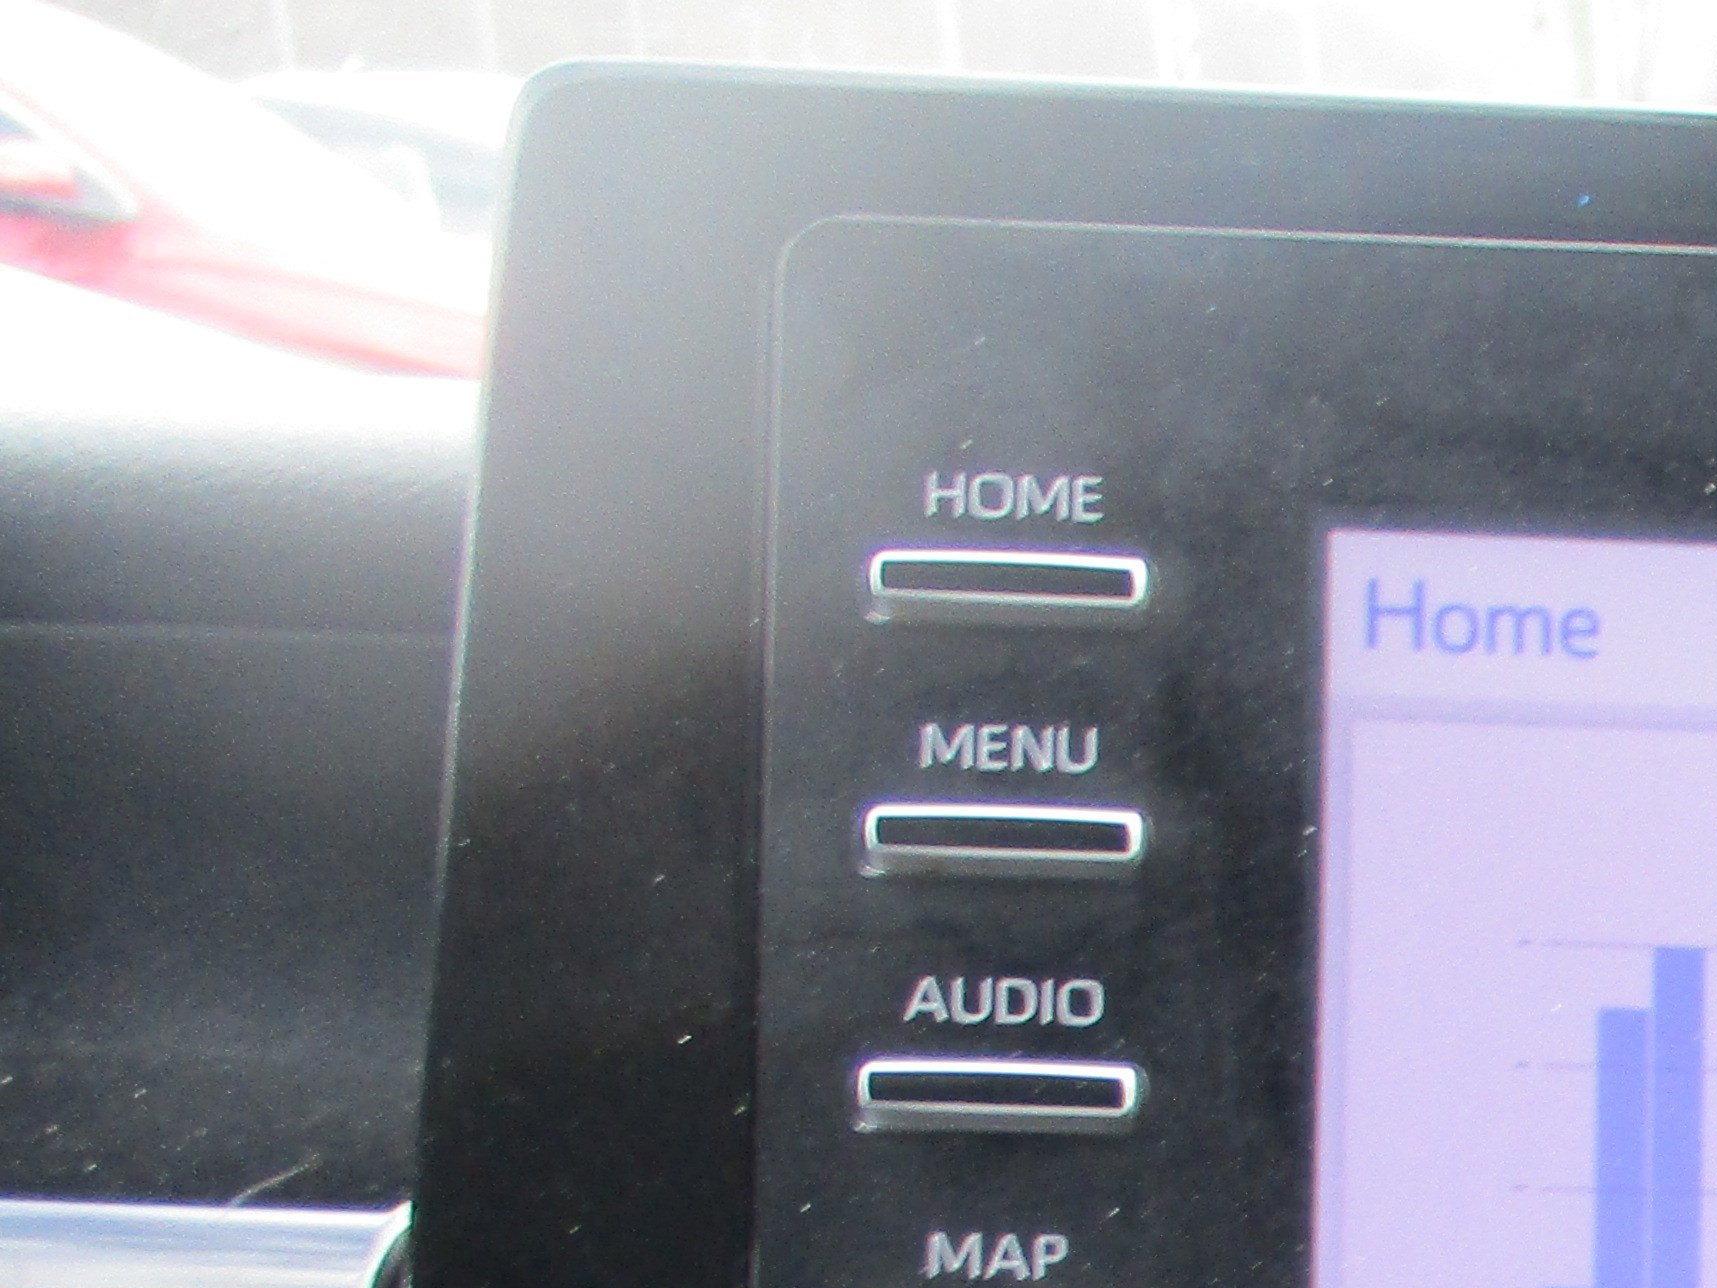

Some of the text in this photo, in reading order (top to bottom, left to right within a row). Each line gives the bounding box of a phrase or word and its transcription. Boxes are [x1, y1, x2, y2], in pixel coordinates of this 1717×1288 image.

[924, 471, 1104, 523] HOME
[1363, 577, 1602, 659] Home
[919, 722, 1099, 775] MENU
[904, 976, 1105, 1028] AUDIO
[922, 1231, 1069, 1282] MAP
